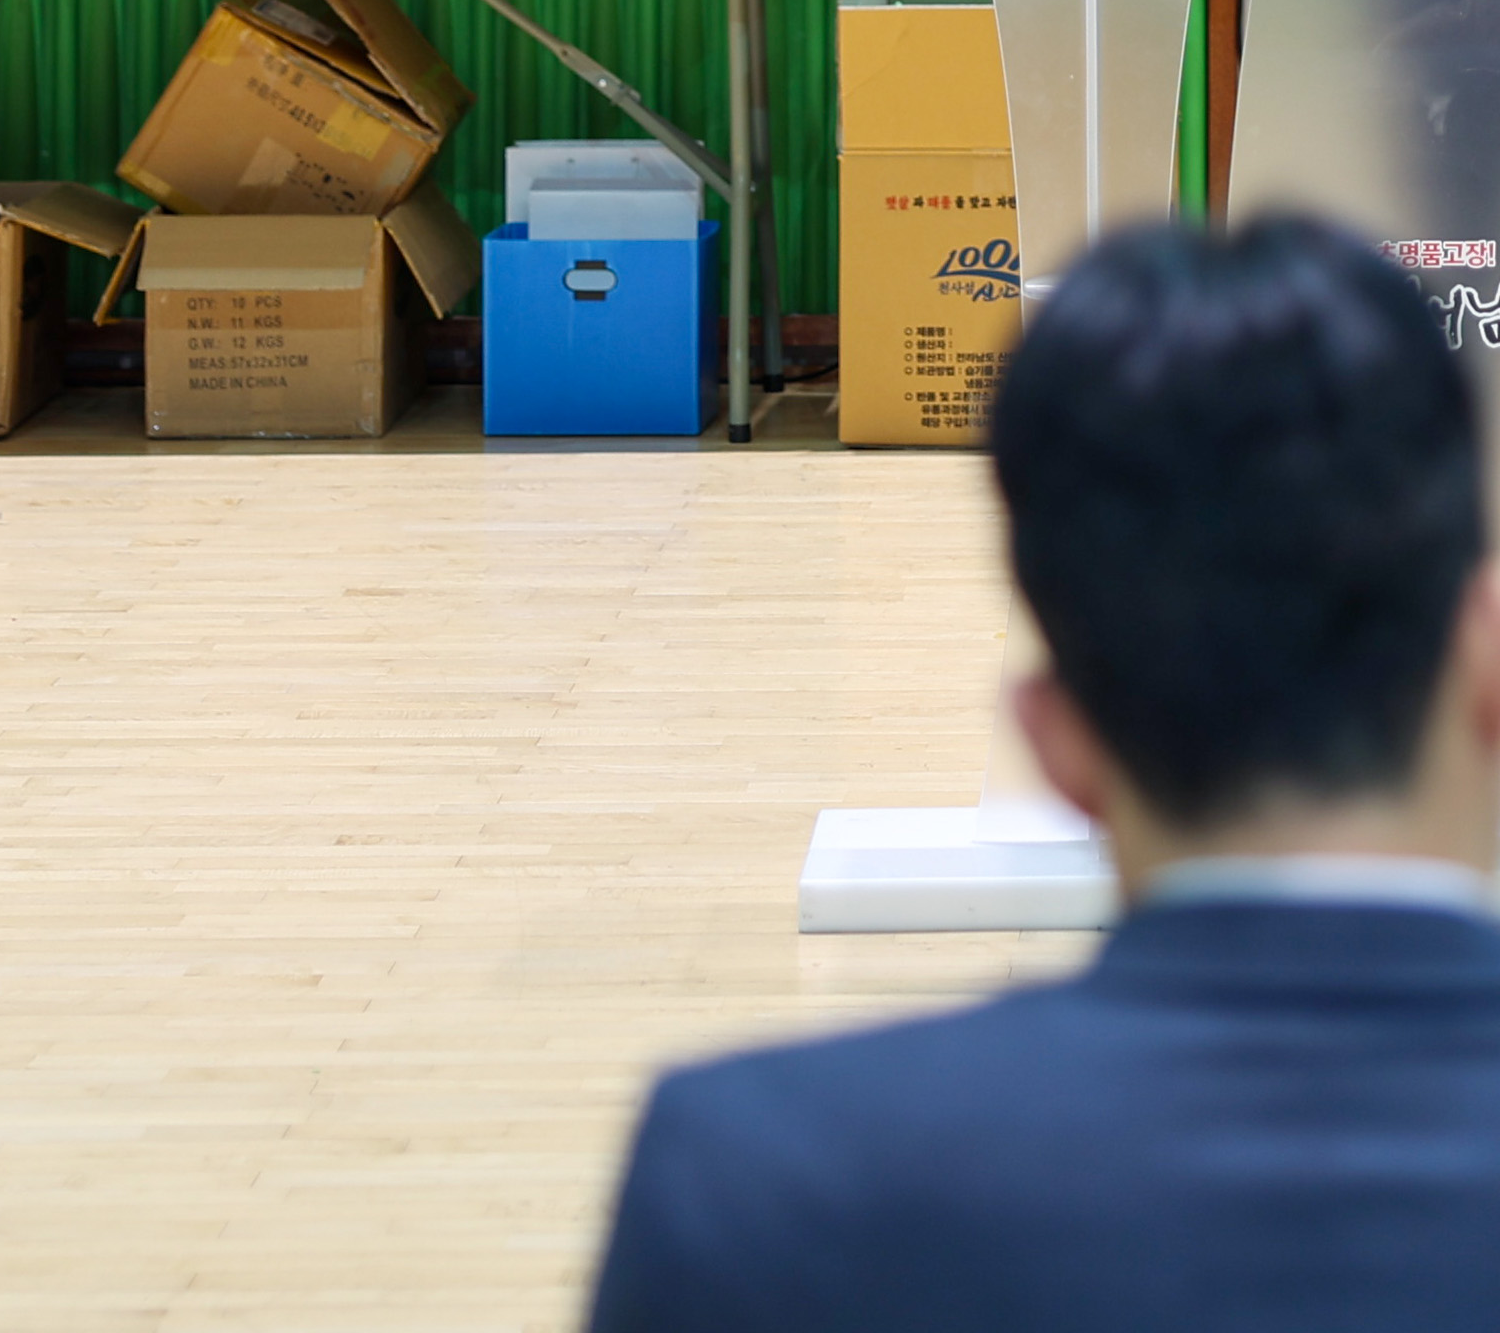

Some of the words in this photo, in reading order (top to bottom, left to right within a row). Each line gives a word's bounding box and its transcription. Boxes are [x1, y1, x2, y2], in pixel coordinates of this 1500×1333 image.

[254, 295, 283, 309] PCS
[253, 314, 283, 329] KGS
[255, 335, 284, 349] KGS
[188, 376, 228, 391] MADE
[229, 376, 244, 389] IN
[246, 375, 289, 390] CHINA
